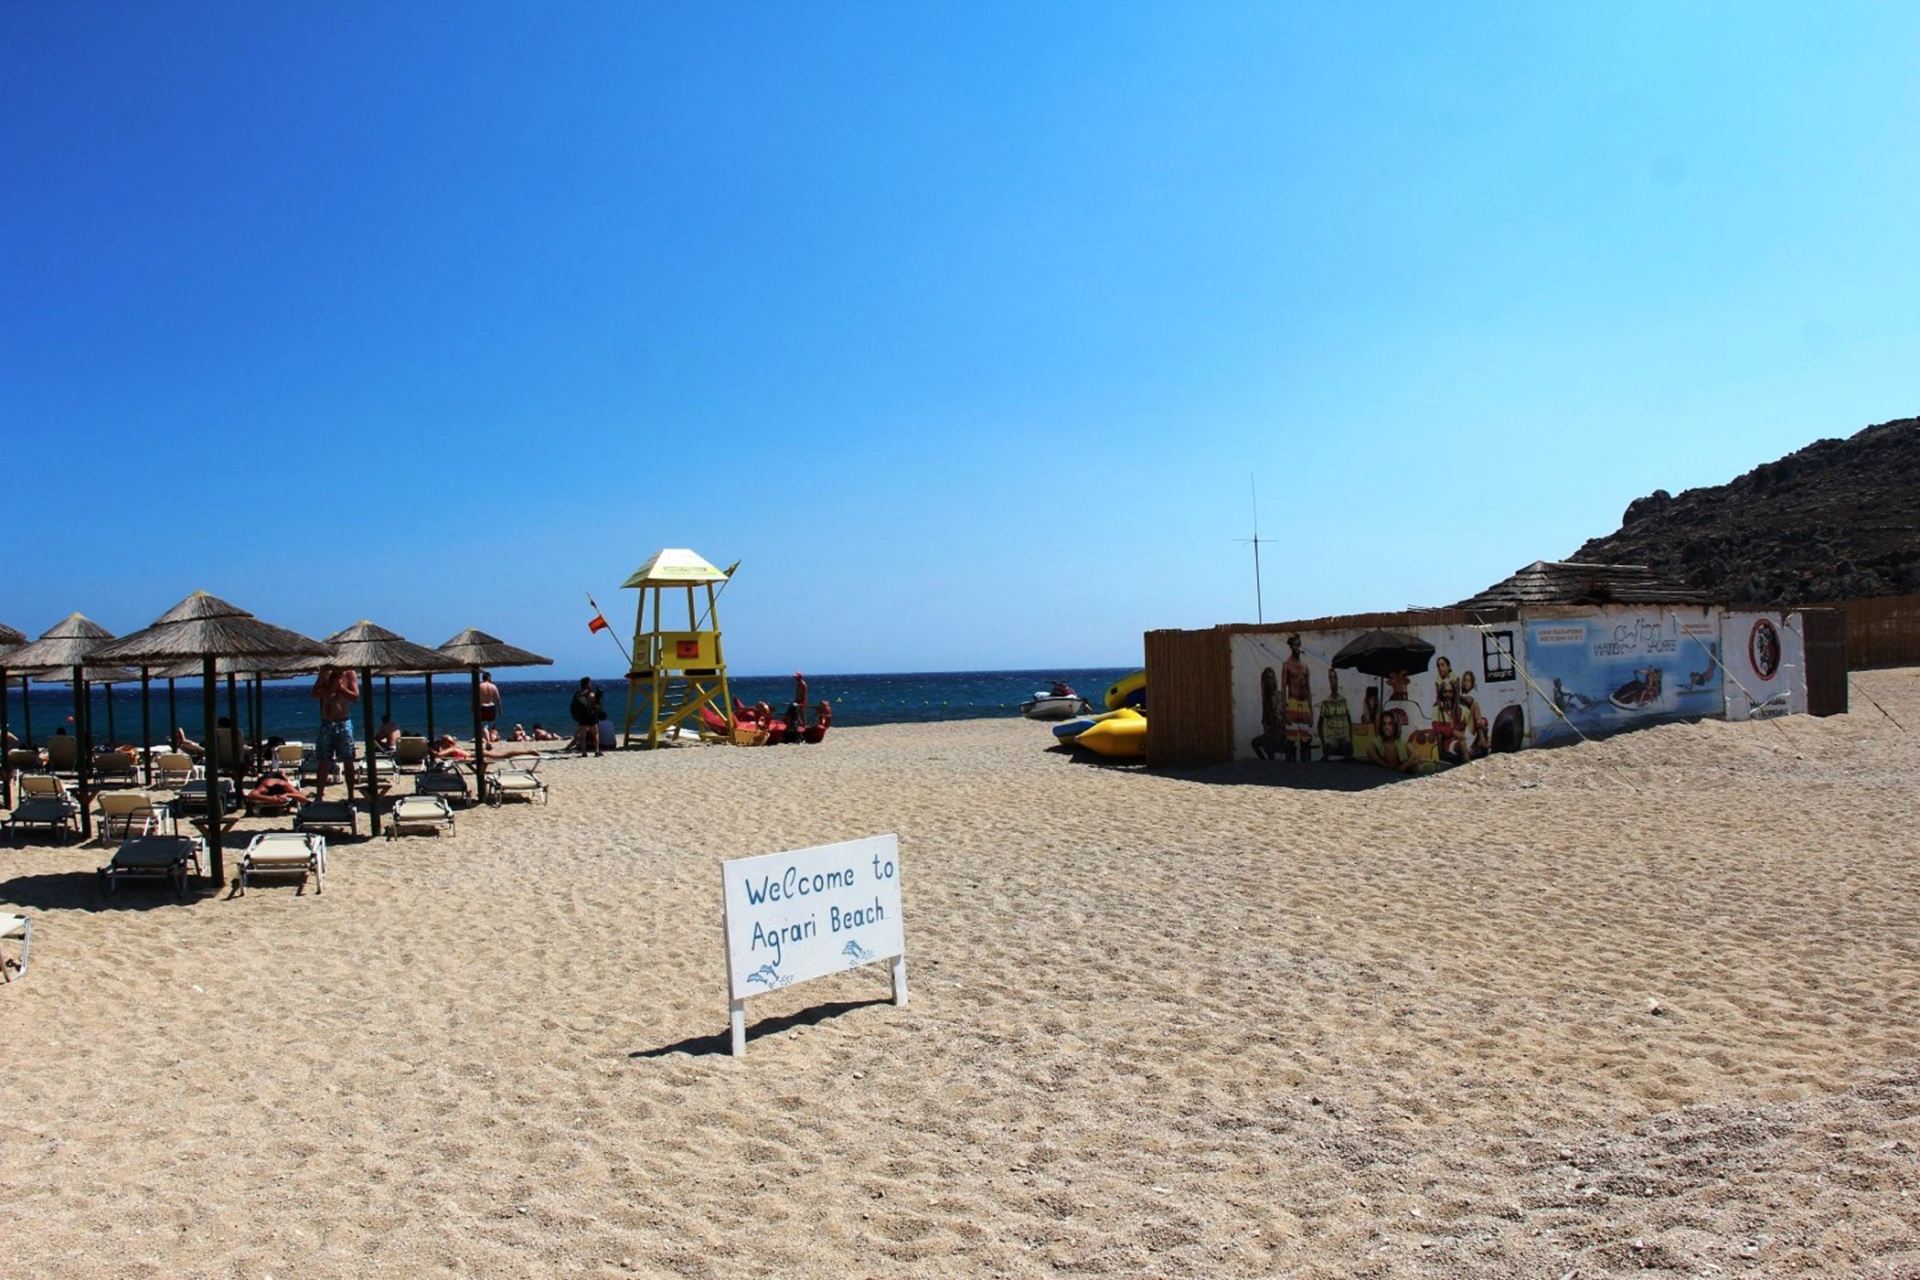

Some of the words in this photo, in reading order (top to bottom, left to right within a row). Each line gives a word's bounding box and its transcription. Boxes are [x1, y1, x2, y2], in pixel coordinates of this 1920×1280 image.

[745, 866, 855, 906] Welcome
[872, 853, 894, 880] to
[751, 913, 817, 967] Agrari
[830, 896, 885, 933] Beach
